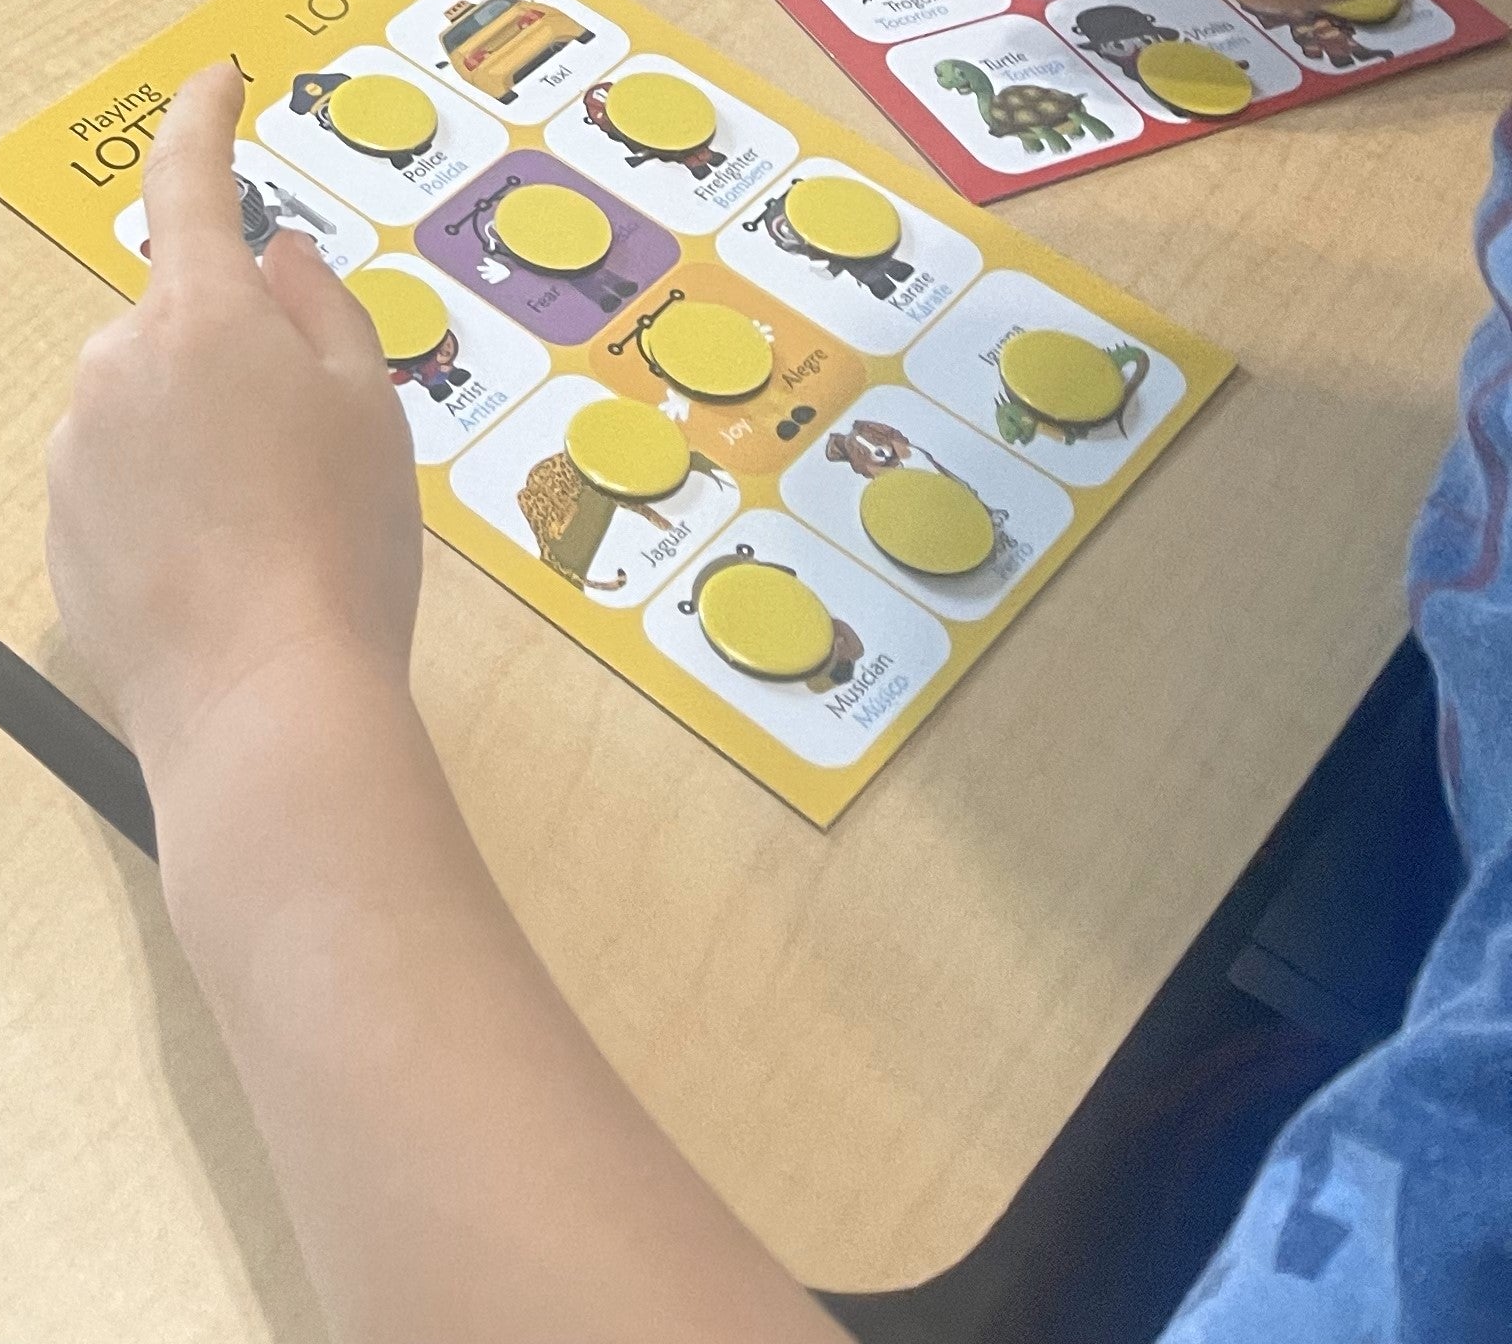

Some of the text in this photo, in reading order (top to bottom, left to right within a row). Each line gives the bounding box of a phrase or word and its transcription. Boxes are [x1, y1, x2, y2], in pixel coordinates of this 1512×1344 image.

[539, 64, 573, 89] Taxi
[980, 50, 1030, 72] Turtle
[1003, 59, 1066, 83] Tortuga
[69, 82, 164, 142] Playing
[403, 148, 449, 185] Police
[694, 146, 760, 204] Firefighter
[712, 159, 775, 211] Bombero
[887, 272, 935, 312] Karate
[781, 346, 829, 391] Alegre
[445, 379, 489, 418] Artist
[458, 388, 509, 434] Artista
[719, 416, 754, 448] Joy
[639, 518, 694, 569] Jaguar
[824, 652, 894, 721] Musician
